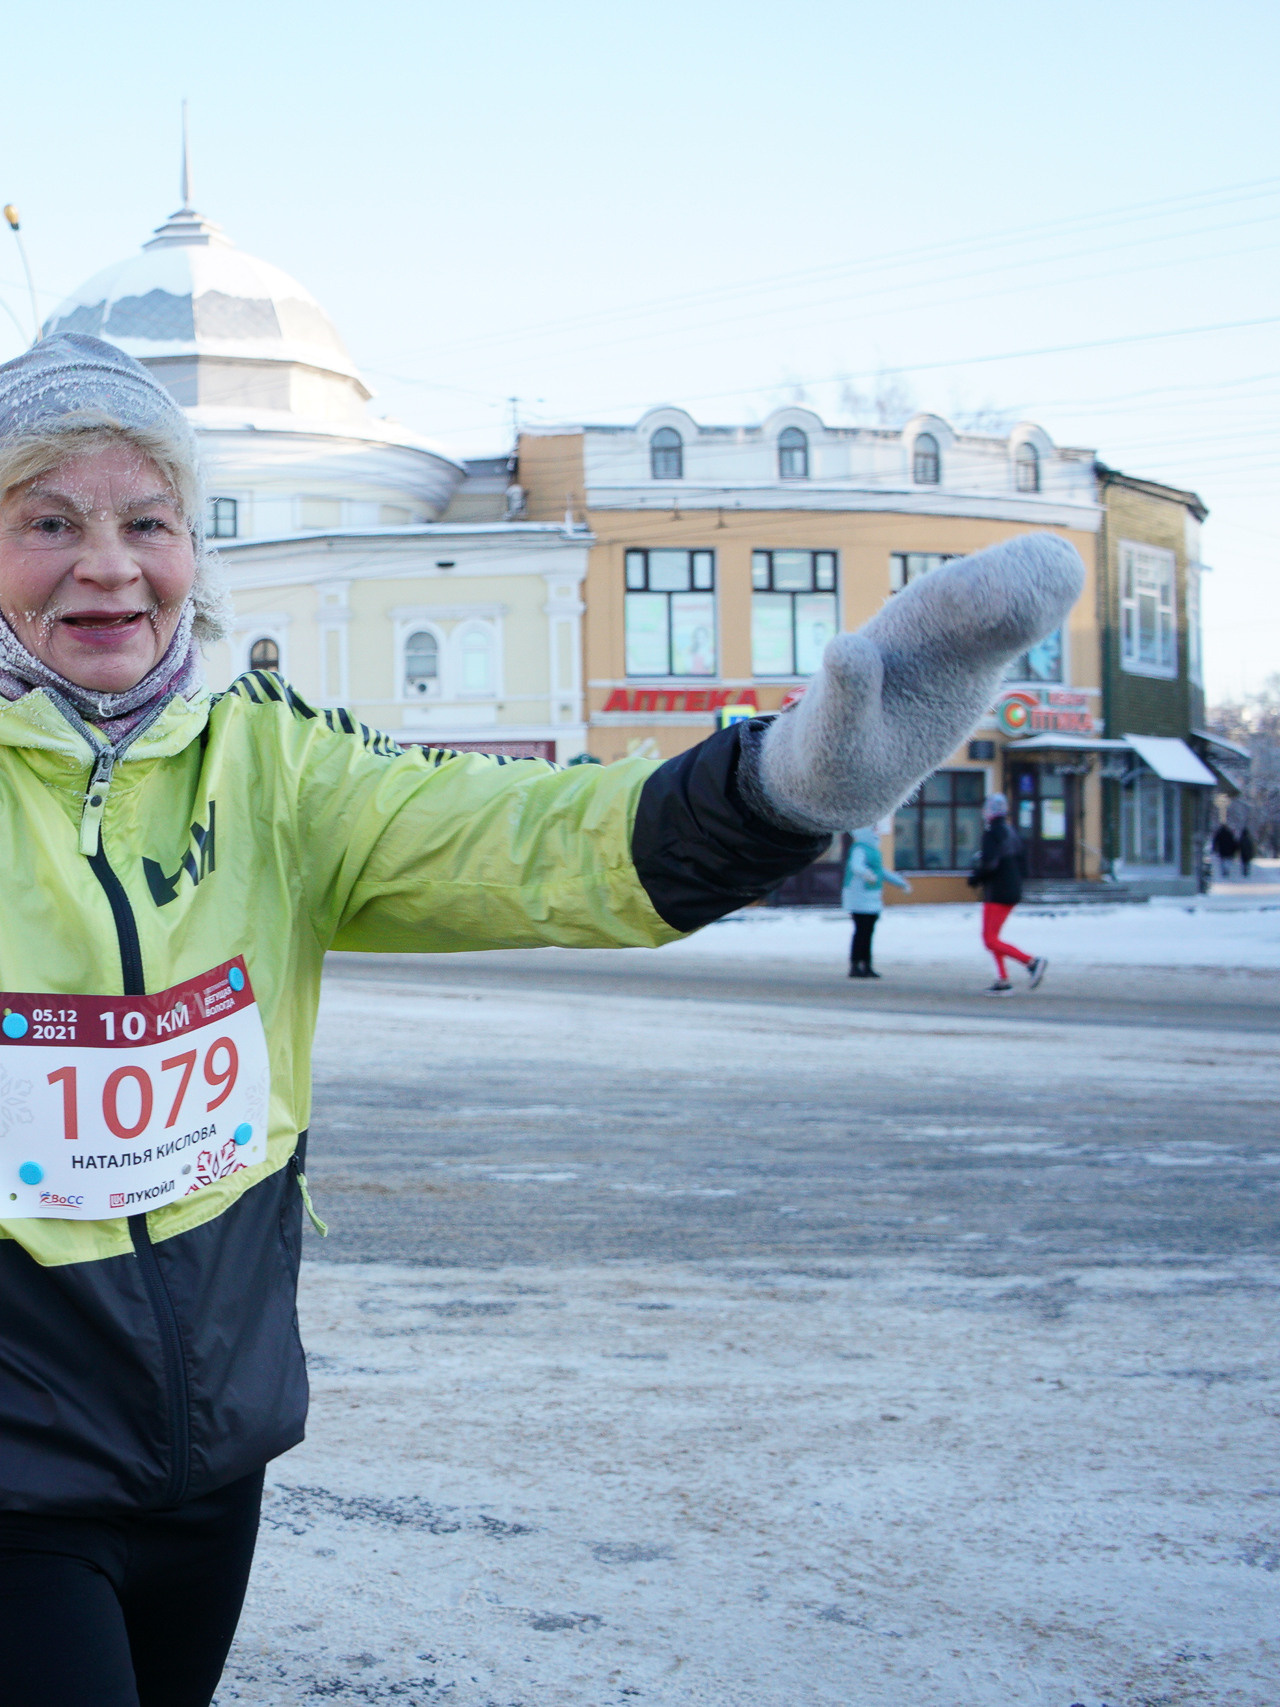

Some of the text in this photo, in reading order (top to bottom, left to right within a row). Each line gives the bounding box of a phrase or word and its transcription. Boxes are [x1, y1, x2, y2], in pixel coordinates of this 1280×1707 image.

[603, 689, 759, 712] АПТЕКА
[32, 1009, 78, 1023] 05.12
[205, 998, 236, 1017] ВОЛОГДА
[32, 1025, 77, 1040] 2021
[99, 1004, 190, 1041] 10 КМ
[47, 1036, 239, 1140] 1079
[72, 1123, 217, 1169] НАТАЛЬЯ КИСЛОВА
[125, 1179, 175, 1205] ЛУКОЙЛ
